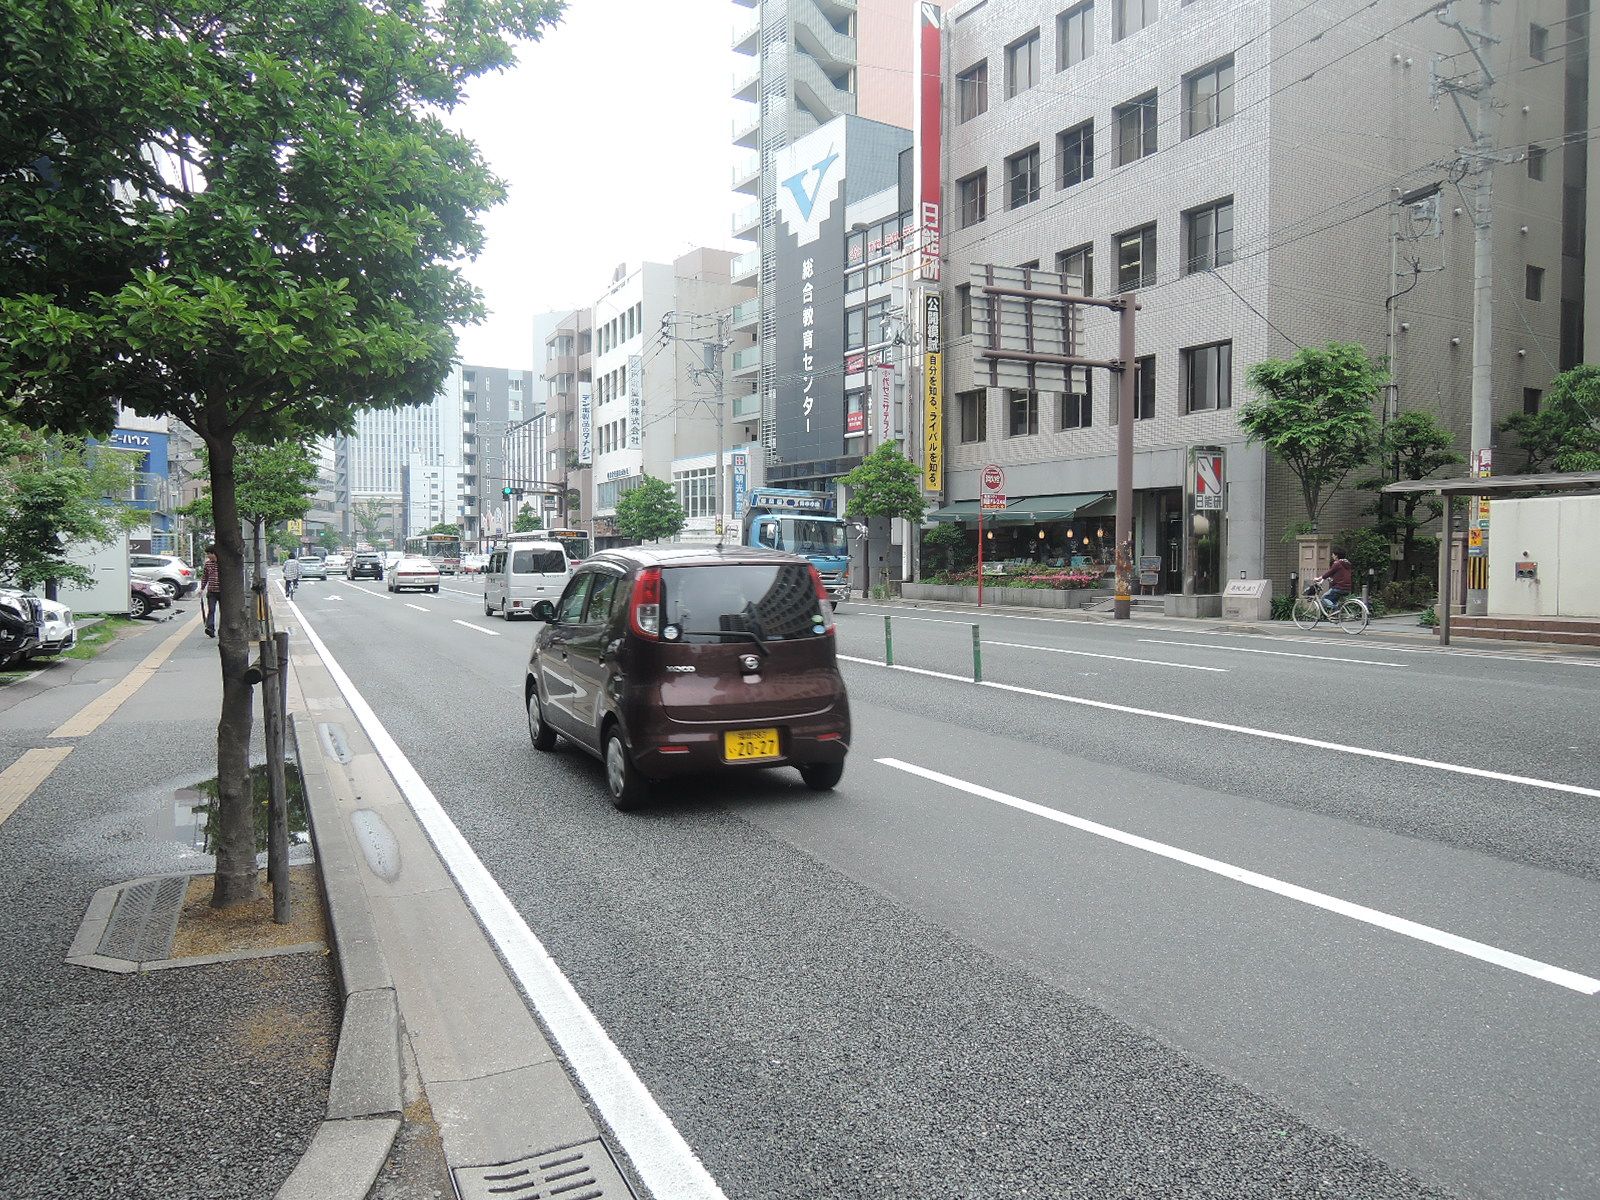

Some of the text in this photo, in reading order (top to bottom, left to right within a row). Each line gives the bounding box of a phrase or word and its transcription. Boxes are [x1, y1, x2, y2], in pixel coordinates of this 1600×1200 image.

[921, 202, 940, 281] 日能研
[802, 257, 814, 433] 総合教育センター
[929, 355, 938, 487] 自分を知る、ライバルを知る。
[1196, 495, 1222, 508] 日能研
